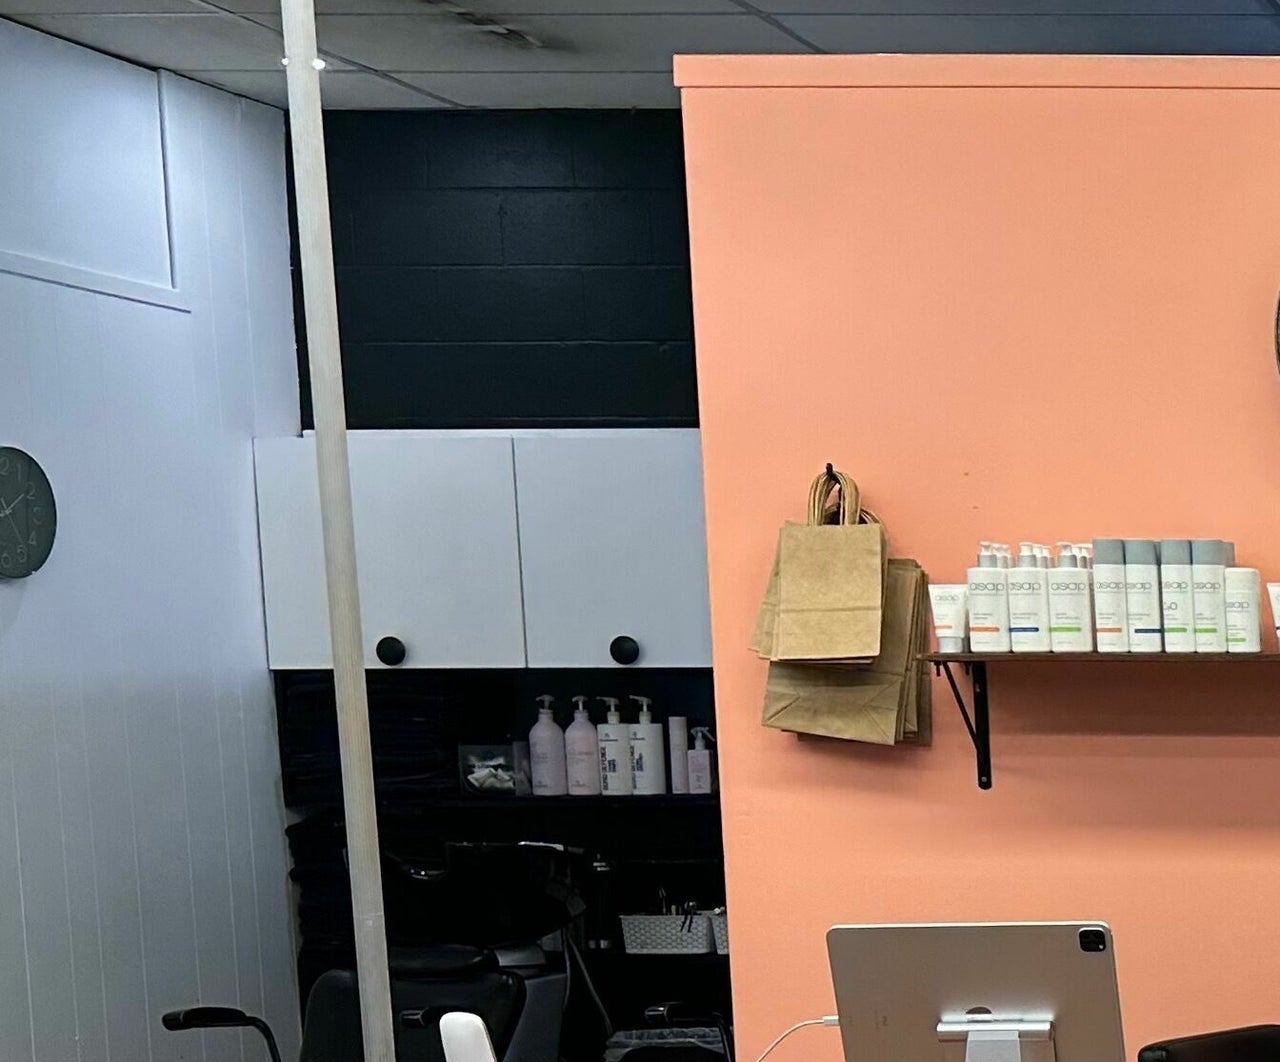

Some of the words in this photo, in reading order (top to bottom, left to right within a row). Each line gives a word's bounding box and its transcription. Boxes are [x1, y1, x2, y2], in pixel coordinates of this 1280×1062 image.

[970, 582, 1005, 592] asap
[1051, 582, 1086, 592] asap
[1164, 581, 1188, 590] sap
[1226, 601, 1250, 610] sap
